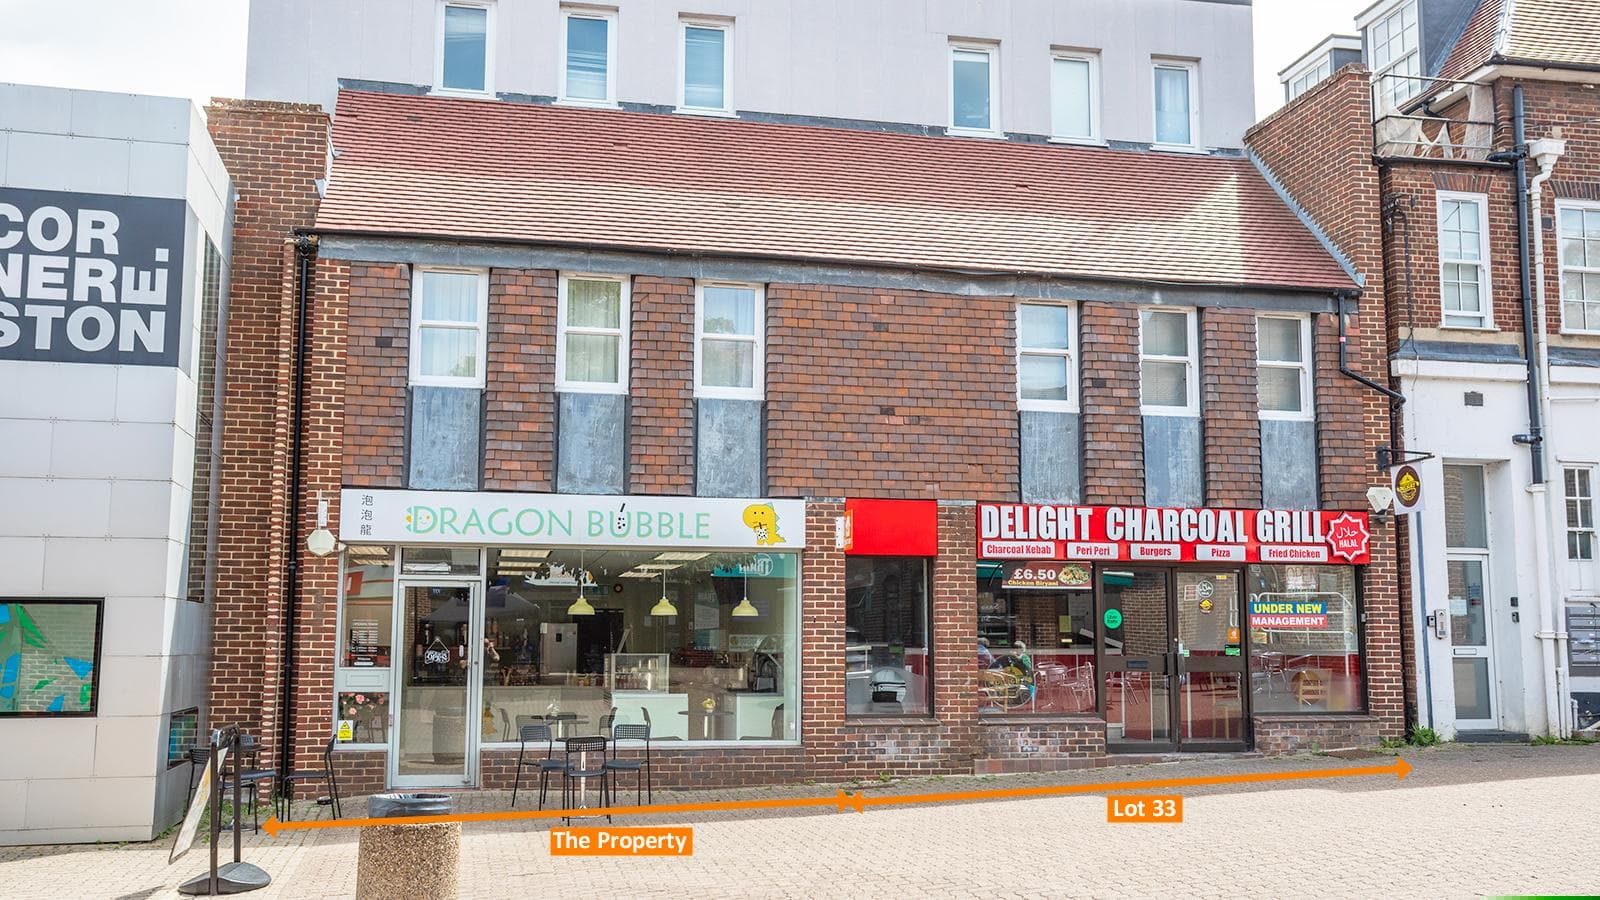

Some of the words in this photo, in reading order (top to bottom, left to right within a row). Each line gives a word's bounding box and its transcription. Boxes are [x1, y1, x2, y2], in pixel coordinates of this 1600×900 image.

[0, 203, 120, 255] COR
[412, 505, 573, 536] DRAGON
[587, 509, 711, 539] BUBBLE
[981, 505, 1093, 540] DELIGHT
[1106, 507, 1248, 542] CHARCOAL
[1256, 510, 1326, 543] GRILL
[1336, 526, 1358, 539] حلال
[1338, 539, 1359, 548] HALAL
[987, 544, 1024, 555] Charcoal
[1025, 545, 1052, 555] Kebab
[1076, 546, 1092, 556] Peri
[1093, 546, 1110, 556] Peri
[1139, 547, 1172, 557] Burgers
[1211, 548, 1231, 558] Pizza
[1268, 549, 1288, 558] Fried
[1289, 549, 1321, 559] Chicken
[1013, 568, 1056, 580] £6.50
[1253, 604, 1294, 614] UNDER
[1295, 604, 1322, 614] NEW
[1252, 616, 1324, 626] MANAGEMENT
